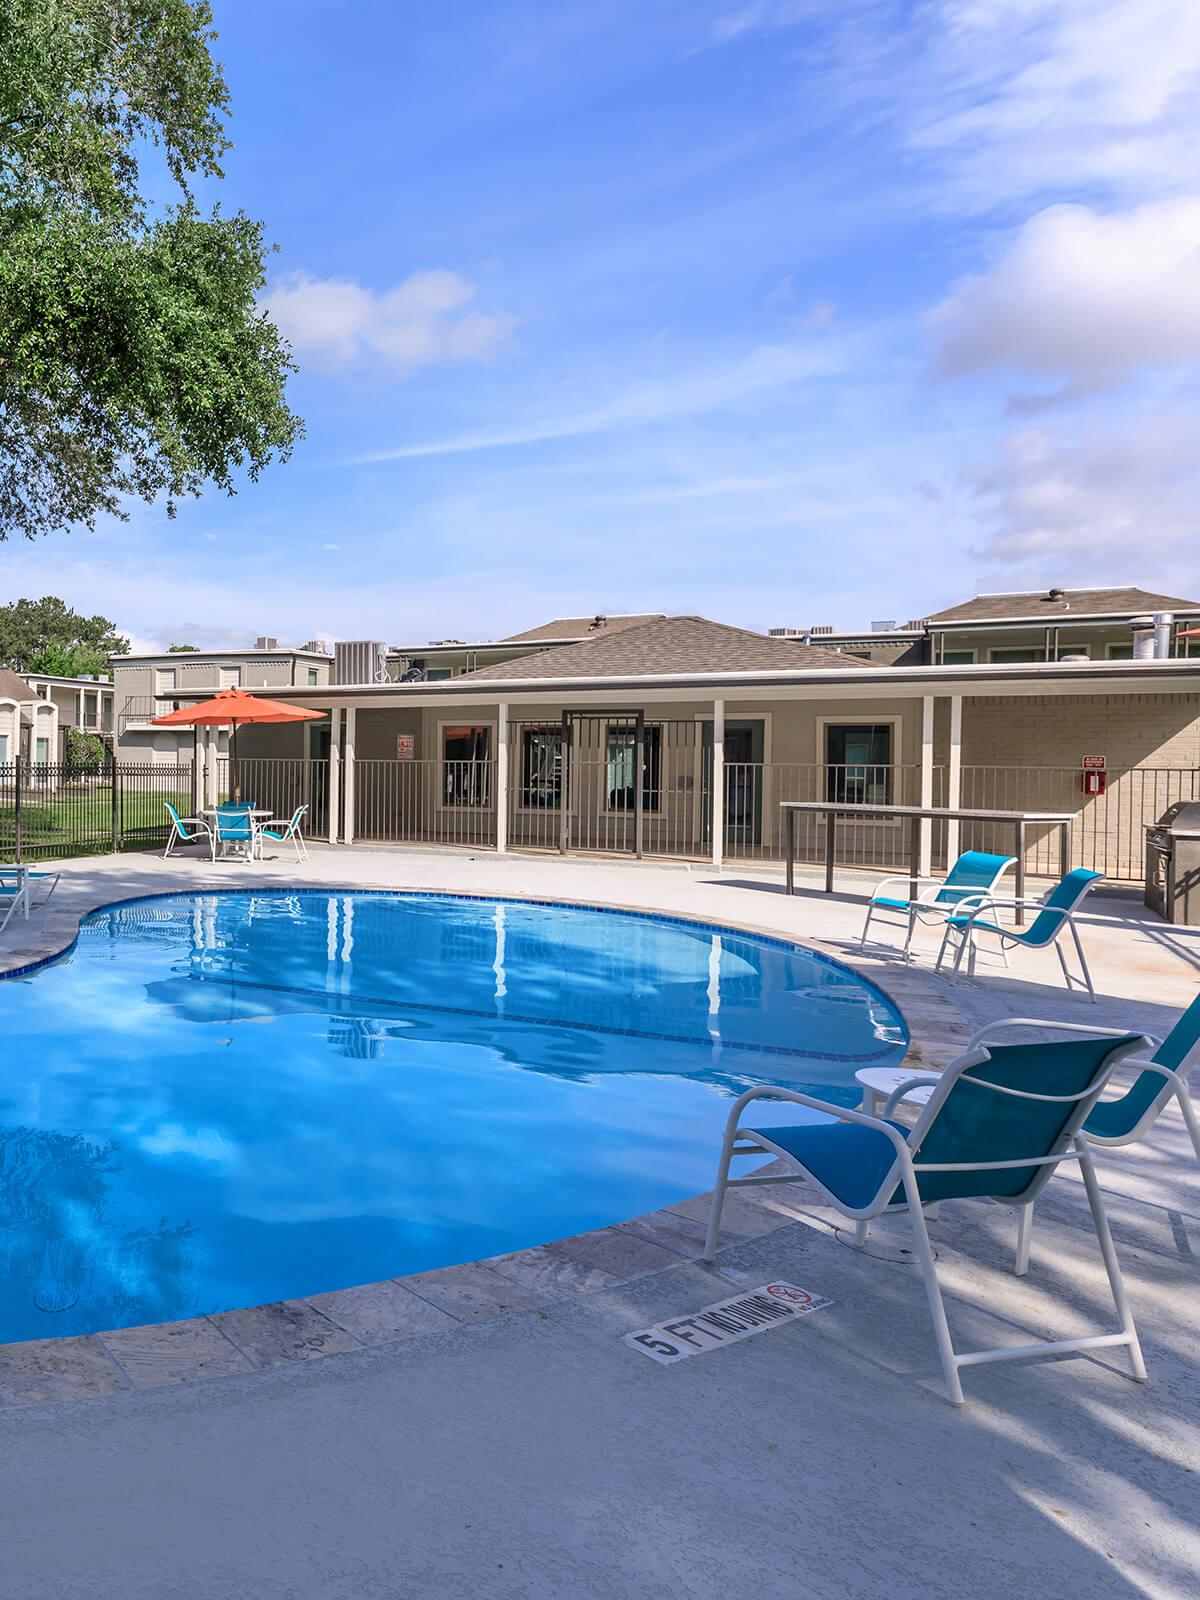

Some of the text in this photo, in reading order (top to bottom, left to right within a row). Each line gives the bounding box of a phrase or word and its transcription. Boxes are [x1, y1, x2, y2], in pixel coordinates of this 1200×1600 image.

[697, 1312, 749, 1335] NO
[720, 1295, 793, 1327] DIVING
[633, 1334, 680, 1356] 5
[663, 1319, 723, 1348] FT
